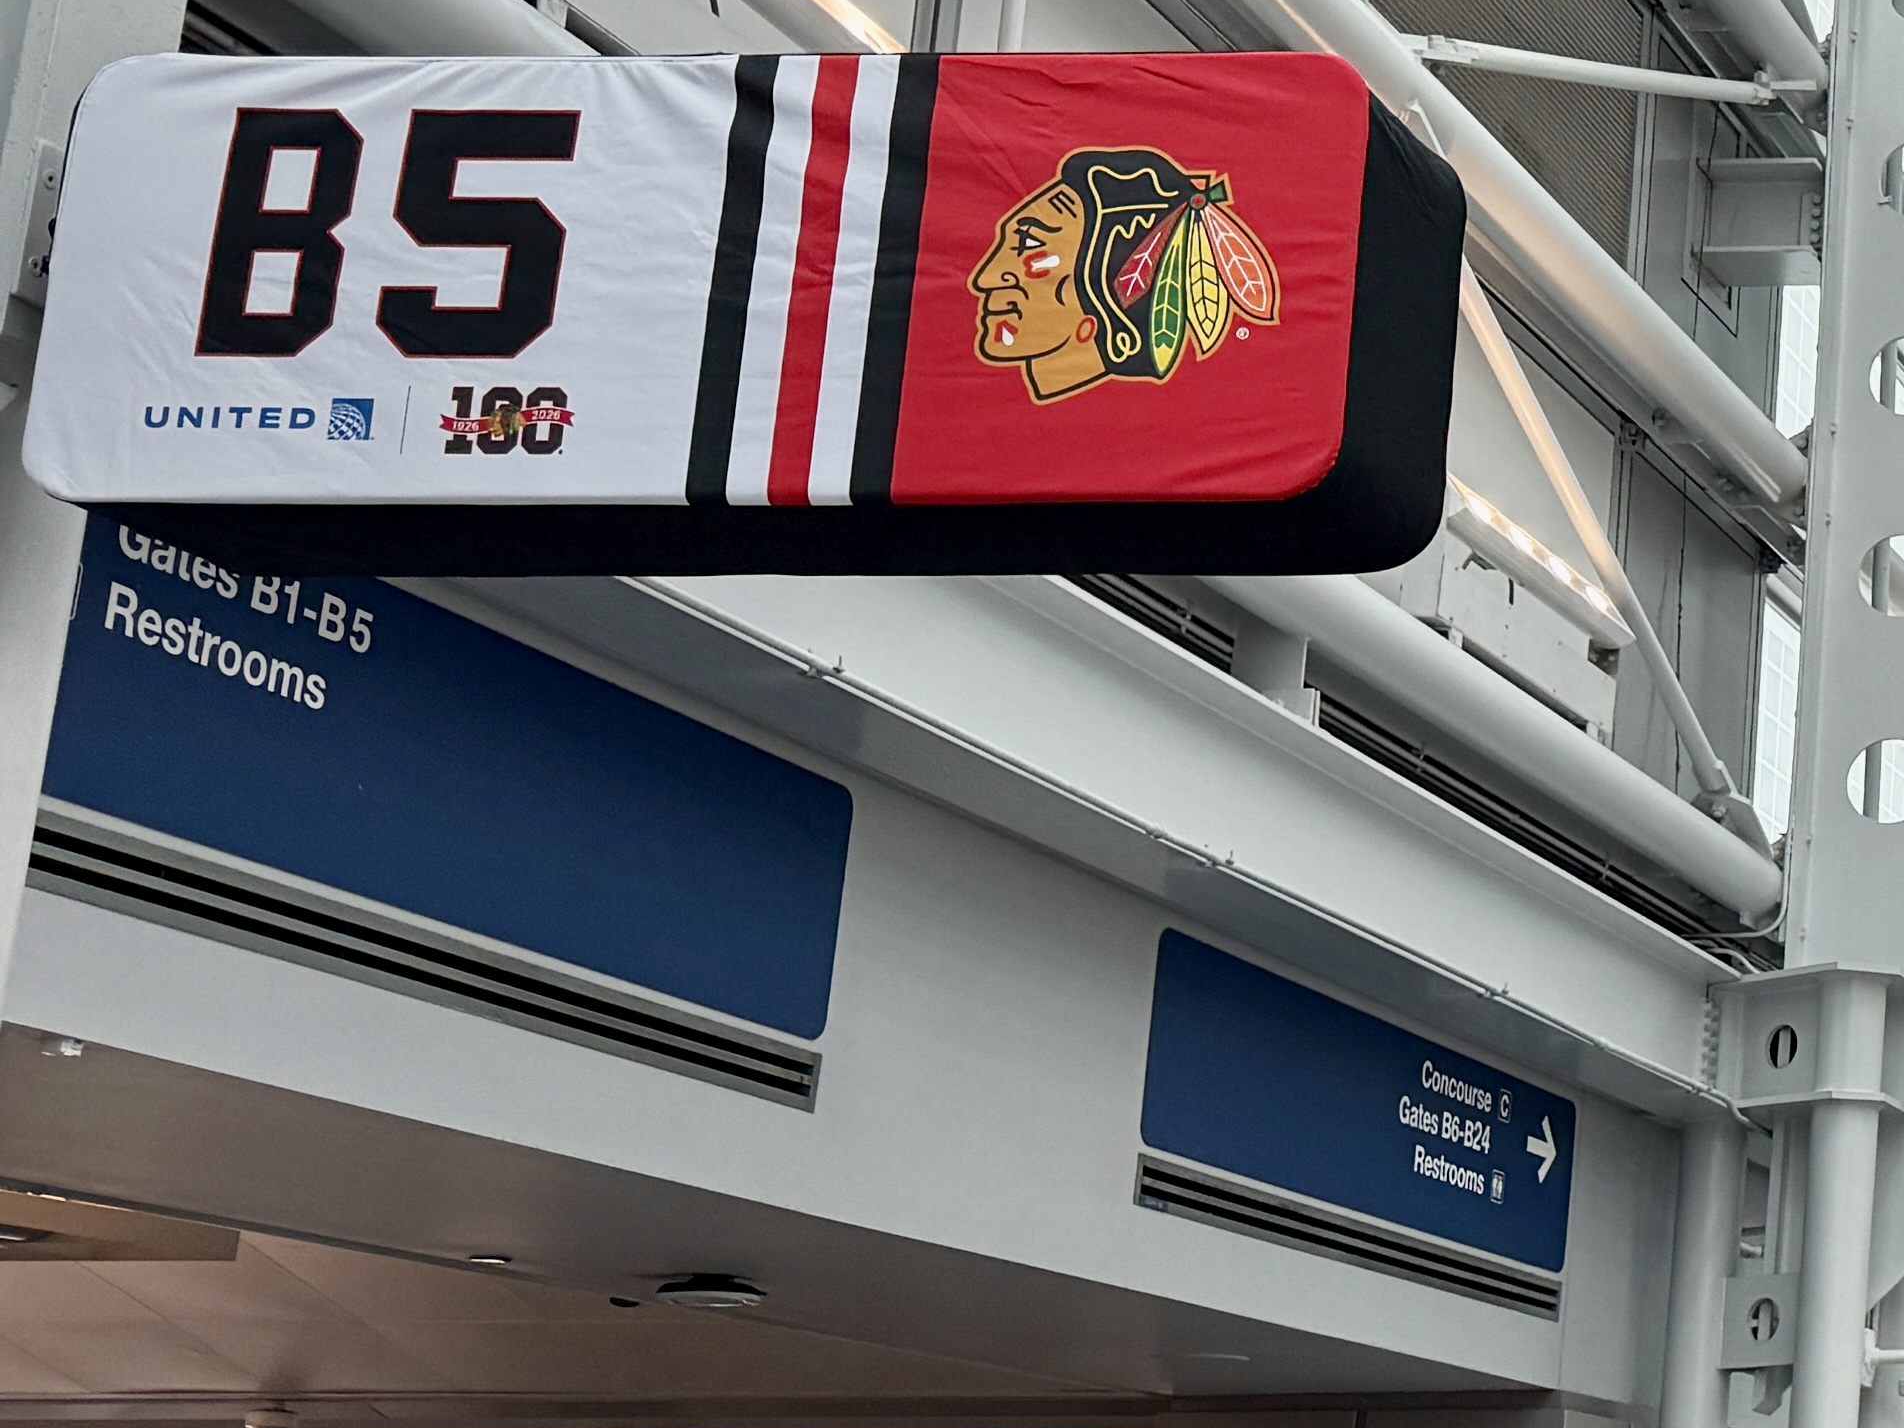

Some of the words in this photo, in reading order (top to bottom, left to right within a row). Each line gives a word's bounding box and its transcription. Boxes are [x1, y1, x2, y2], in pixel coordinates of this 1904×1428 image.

[194, 107, 581, 358] B5
[144, 406, 316, 430] UNITED
[444, 386, 568, 454] 100
[452, 421, 480, 432] 1926
[531, 409, 561, 421] 2026
[119, 525, 239, 599] Gates
[251, 576, 375, 654] B1-B5
[104, 581, 328, 710] Restrooms
[1422, 1060, 1493, 1114] Concourse
[1399, 1096, 1439, 1137] Gates
[1441, 1110, 1491, 1155] B6-B24
[1414, 1144, 1485, 1195] Restrooms
